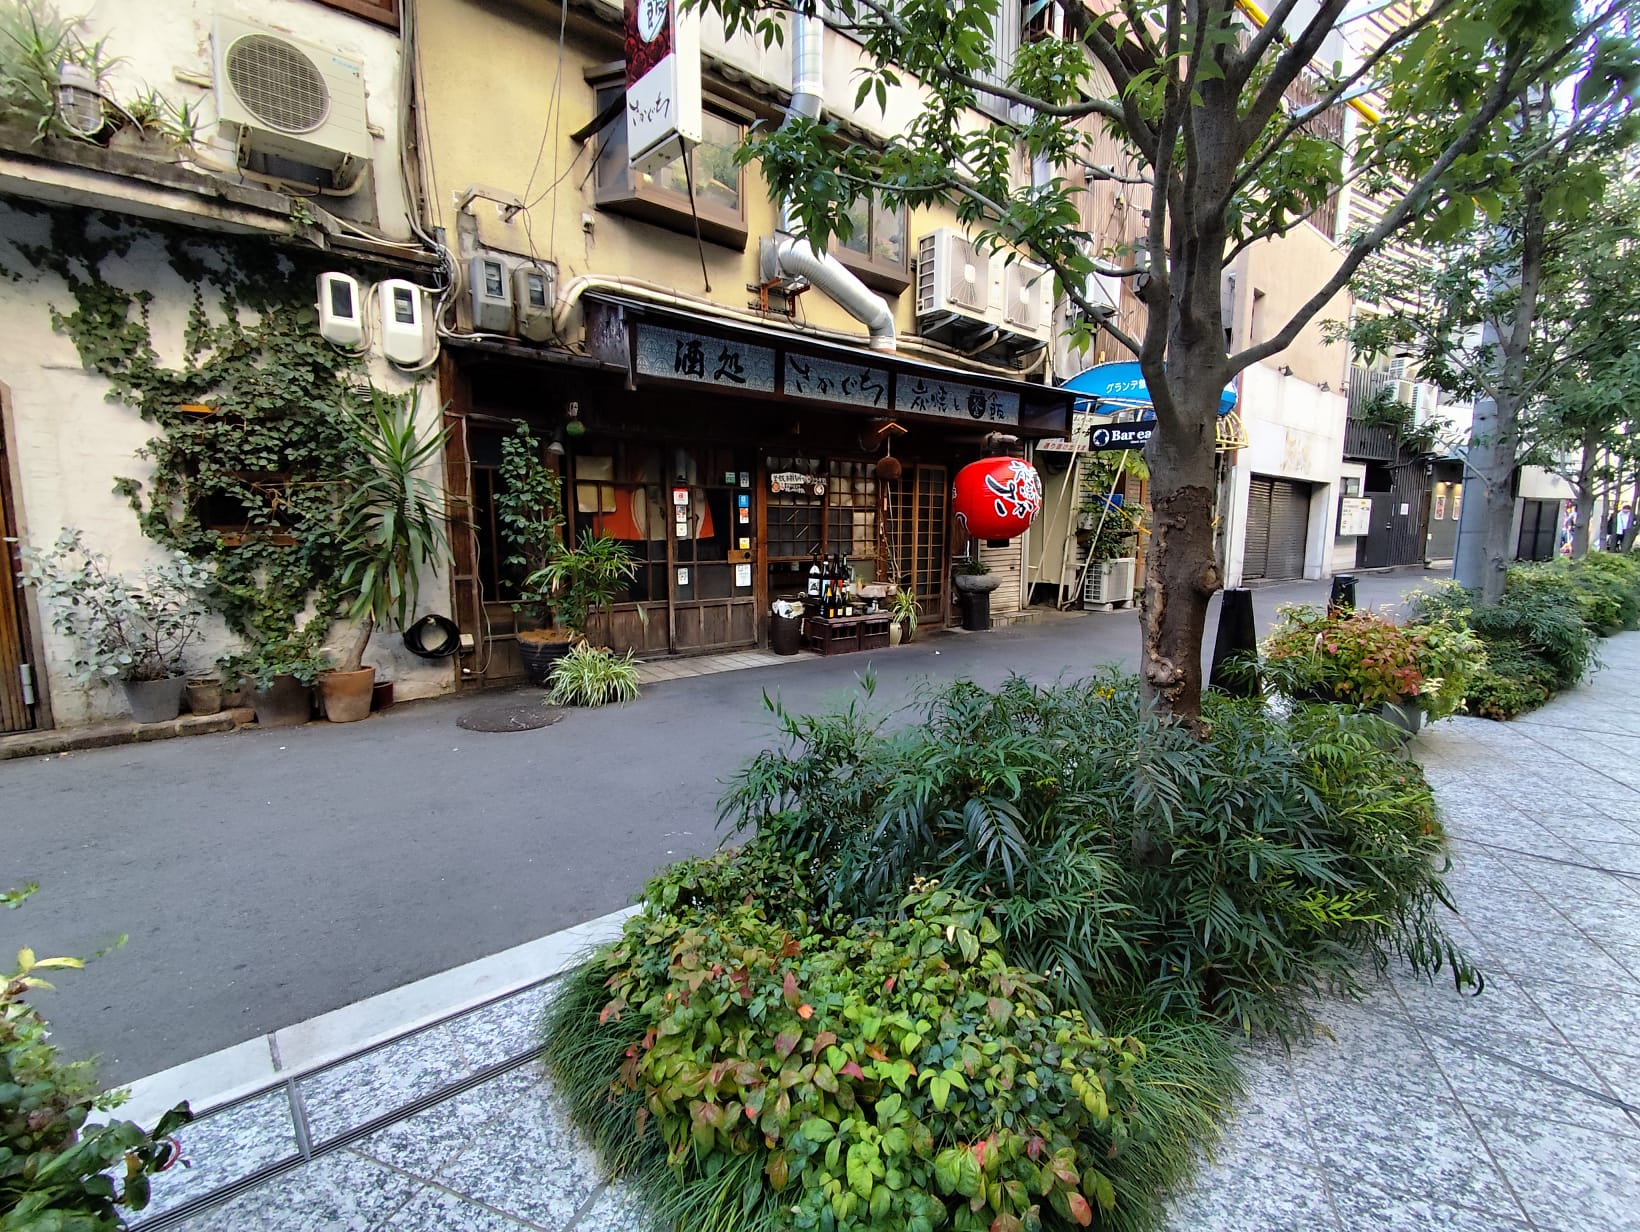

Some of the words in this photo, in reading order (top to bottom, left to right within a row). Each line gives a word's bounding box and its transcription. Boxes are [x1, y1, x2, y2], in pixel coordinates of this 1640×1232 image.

[675, 338, 746, 383] 酒処
[1112, 430, 1136, 442] Bar
[1137, 430, 1151, 440] ea
